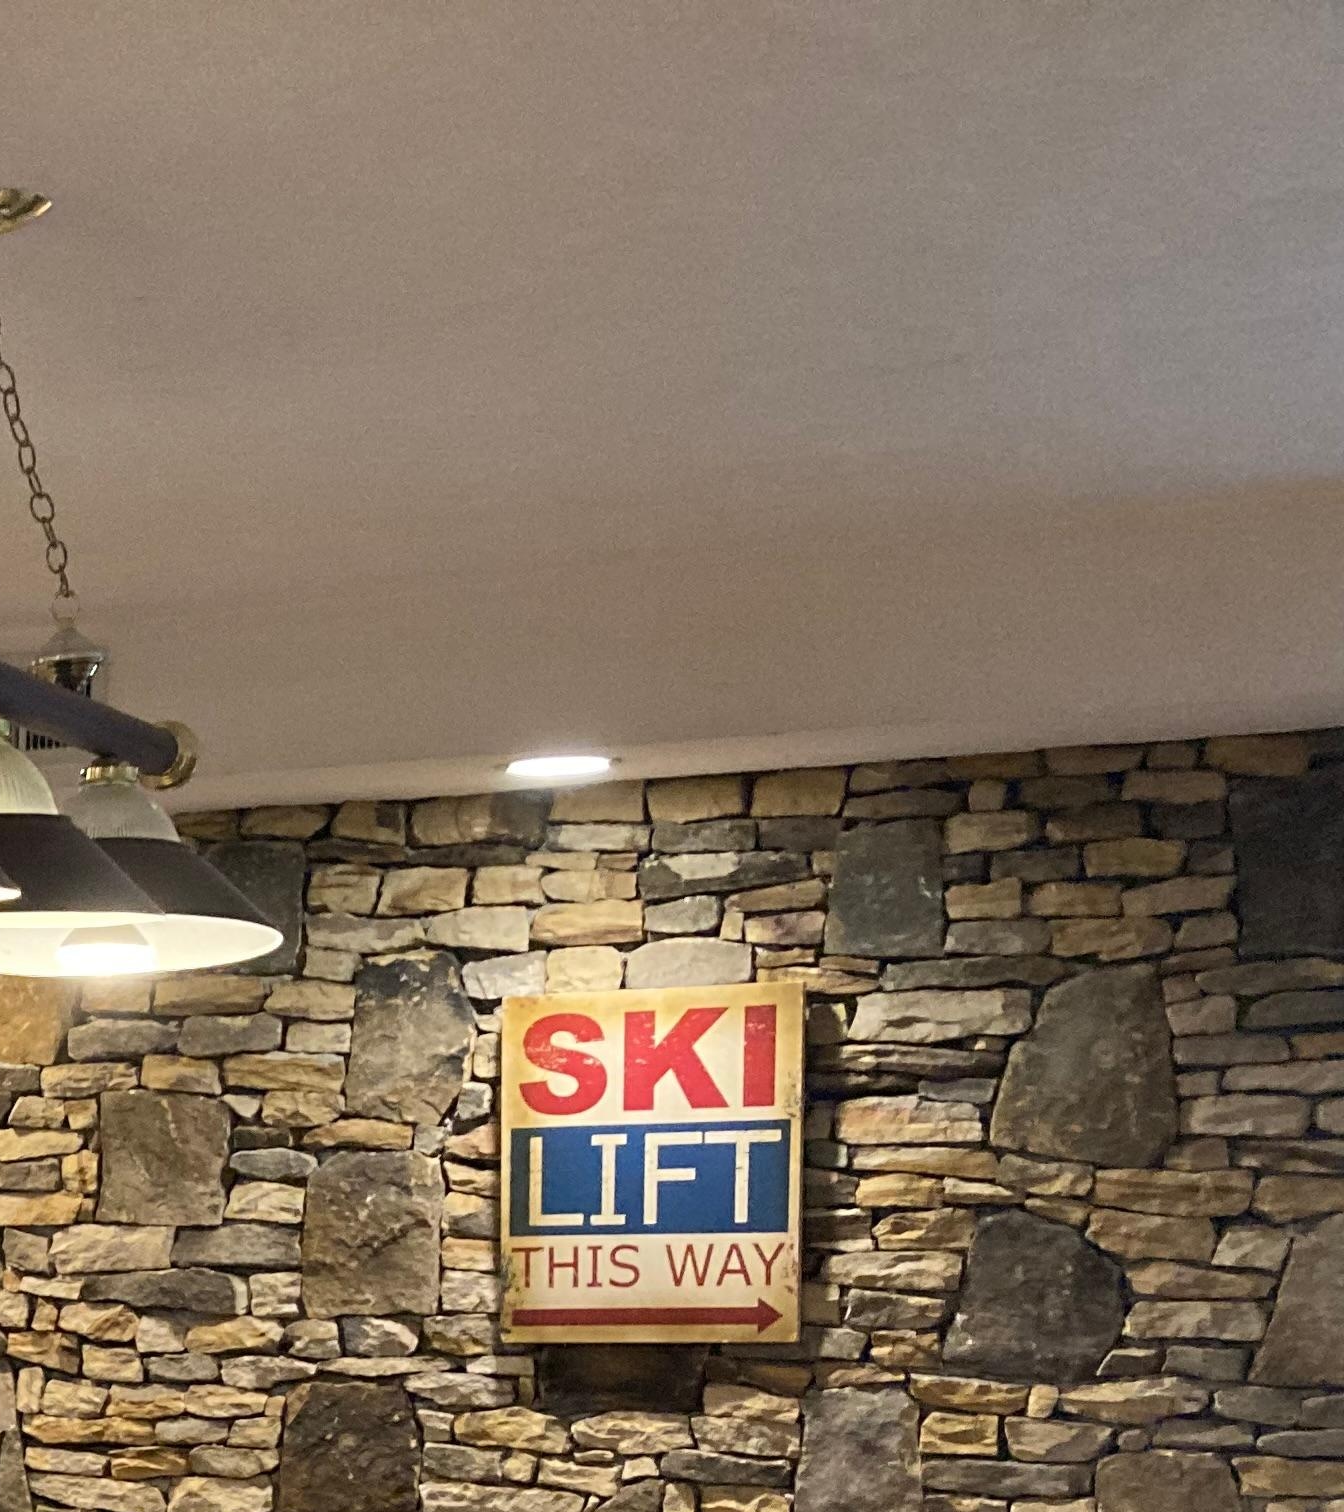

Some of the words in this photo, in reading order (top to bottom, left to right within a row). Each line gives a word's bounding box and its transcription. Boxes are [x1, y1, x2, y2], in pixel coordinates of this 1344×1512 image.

[519, 1004, 777, 1115] SKI
[529, 1129, 782, 1226] LIFT
[511, 1245, 640, 1287] THIS
[666, 1243, 785, 1286] WAY
